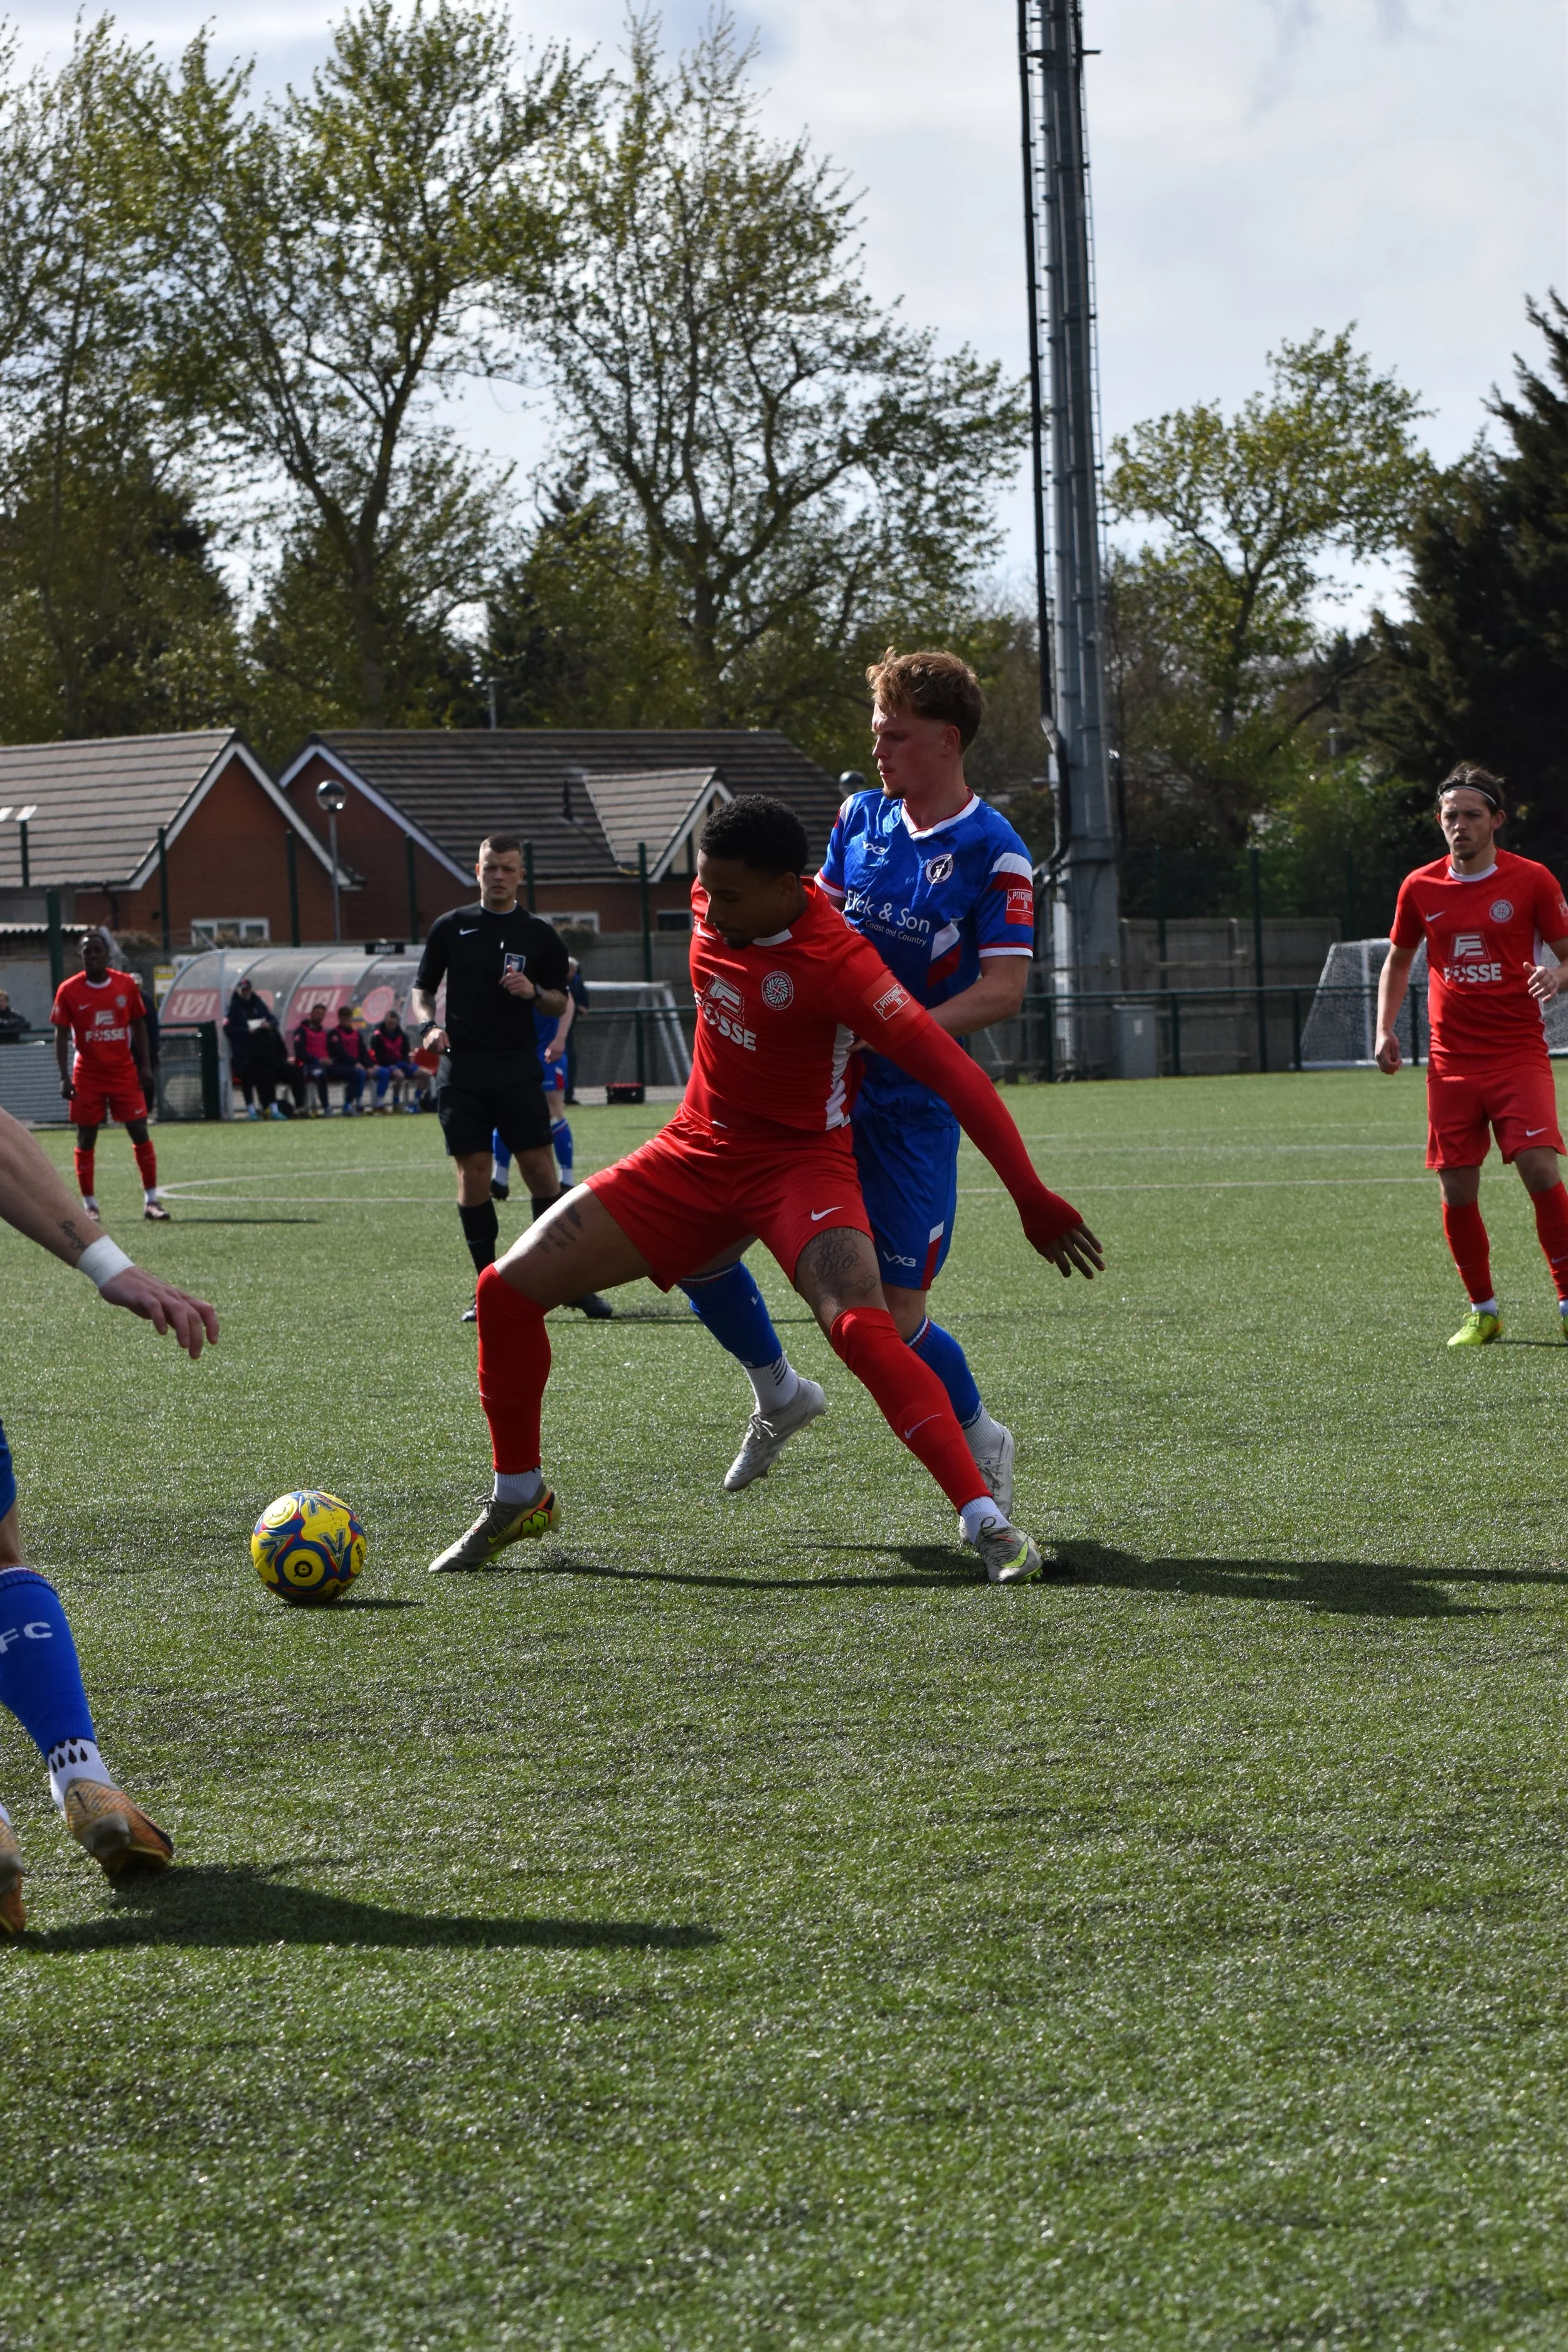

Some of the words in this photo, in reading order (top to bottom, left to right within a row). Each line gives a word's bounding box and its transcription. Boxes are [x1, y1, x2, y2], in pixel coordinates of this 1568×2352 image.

[878, 903, 893, 922] &
[896, 908, 930, 934] Son
[865, 919, 884, 933] Coast
[885, 928, 898, 937] and
[898, 931, 927, 948] Country
[1443, 963, 1502, 983] FOSSE
[879, 987, 902, 1009] PITCHING
[883, 1251, 916, 1268] VX3
